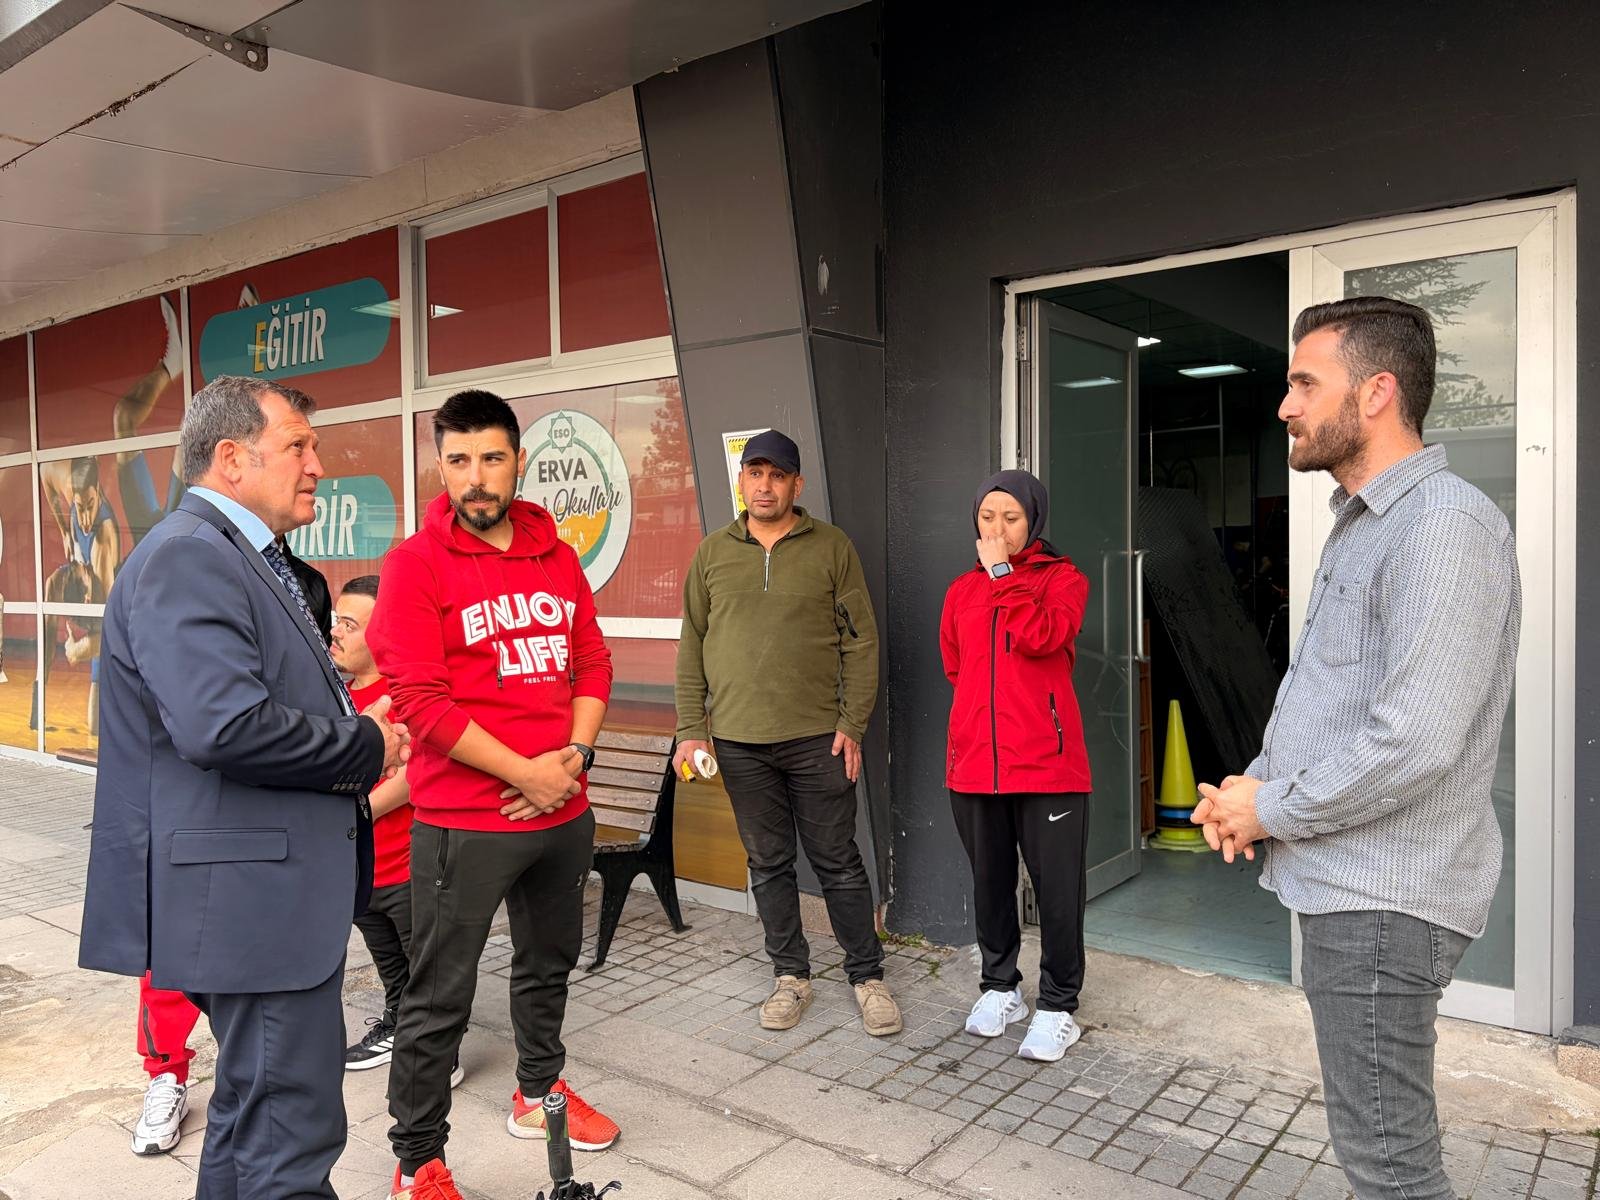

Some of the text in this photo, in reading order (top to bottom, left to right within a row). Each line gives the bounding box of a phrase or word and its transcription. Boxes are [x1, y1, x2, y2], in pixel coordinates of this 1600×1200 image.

[254, 297, 327, 373] EĞİTİR
[553, 428, 570, 439] ESO
[537, 457, 588, 484] ERVA
[461, 591, 577, 647] ENJOY
[491, 634, 569, 677] LIFE
